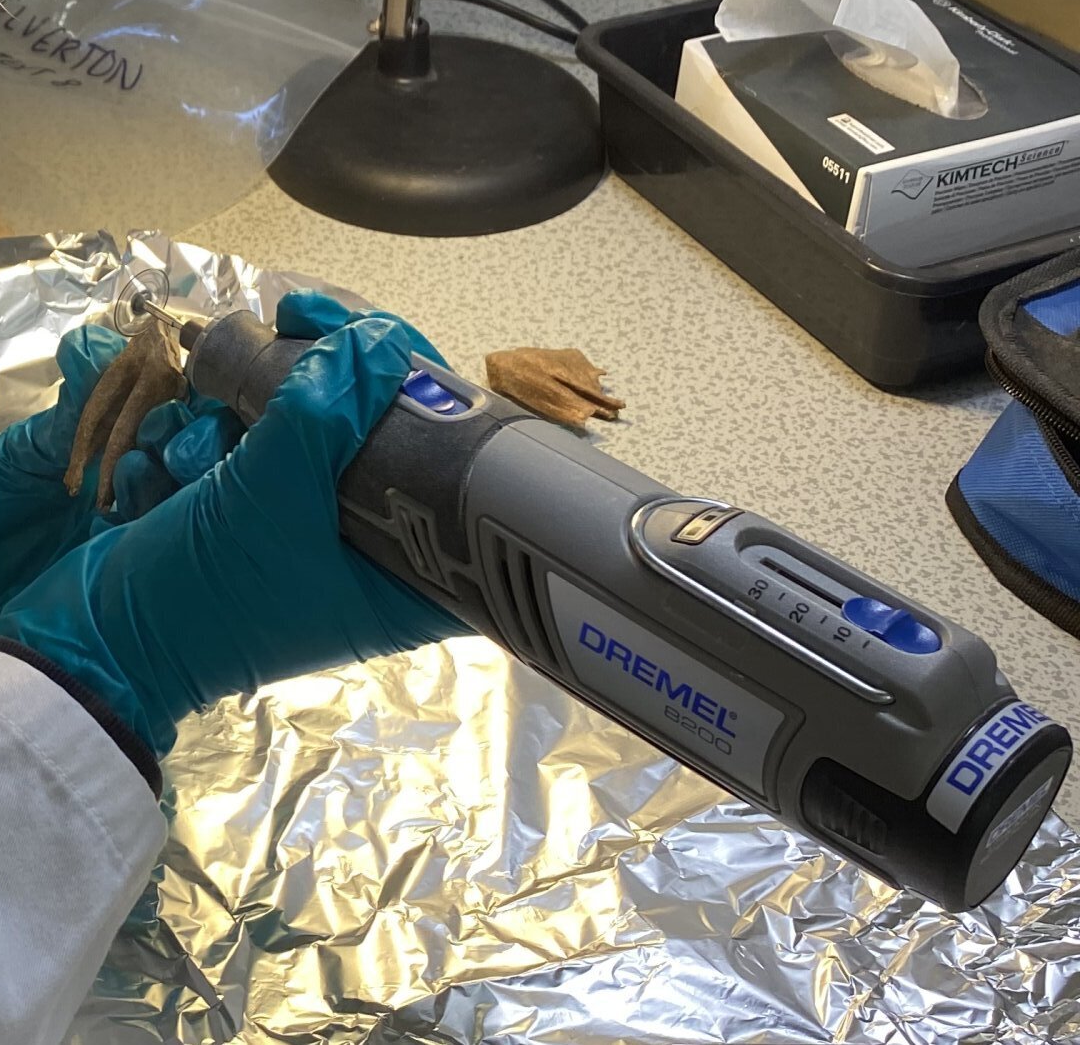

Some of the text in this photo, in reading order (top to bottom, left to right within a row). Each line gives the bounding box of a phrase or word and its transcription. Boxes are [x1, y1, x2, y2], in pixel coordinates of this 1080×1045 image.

[822, 156, 850, 184] 05511
[936, 155, 1018, 188] KIMTECH
[1020, 146, 1060, 163] Science
[748, 579, 769, 600] 30
[789, 602, 810, 623] 20
[833, 626, 852, 643] 10
[578, 622, 737, 739] DREMEL
[664, 705, 732, 756] 8200
